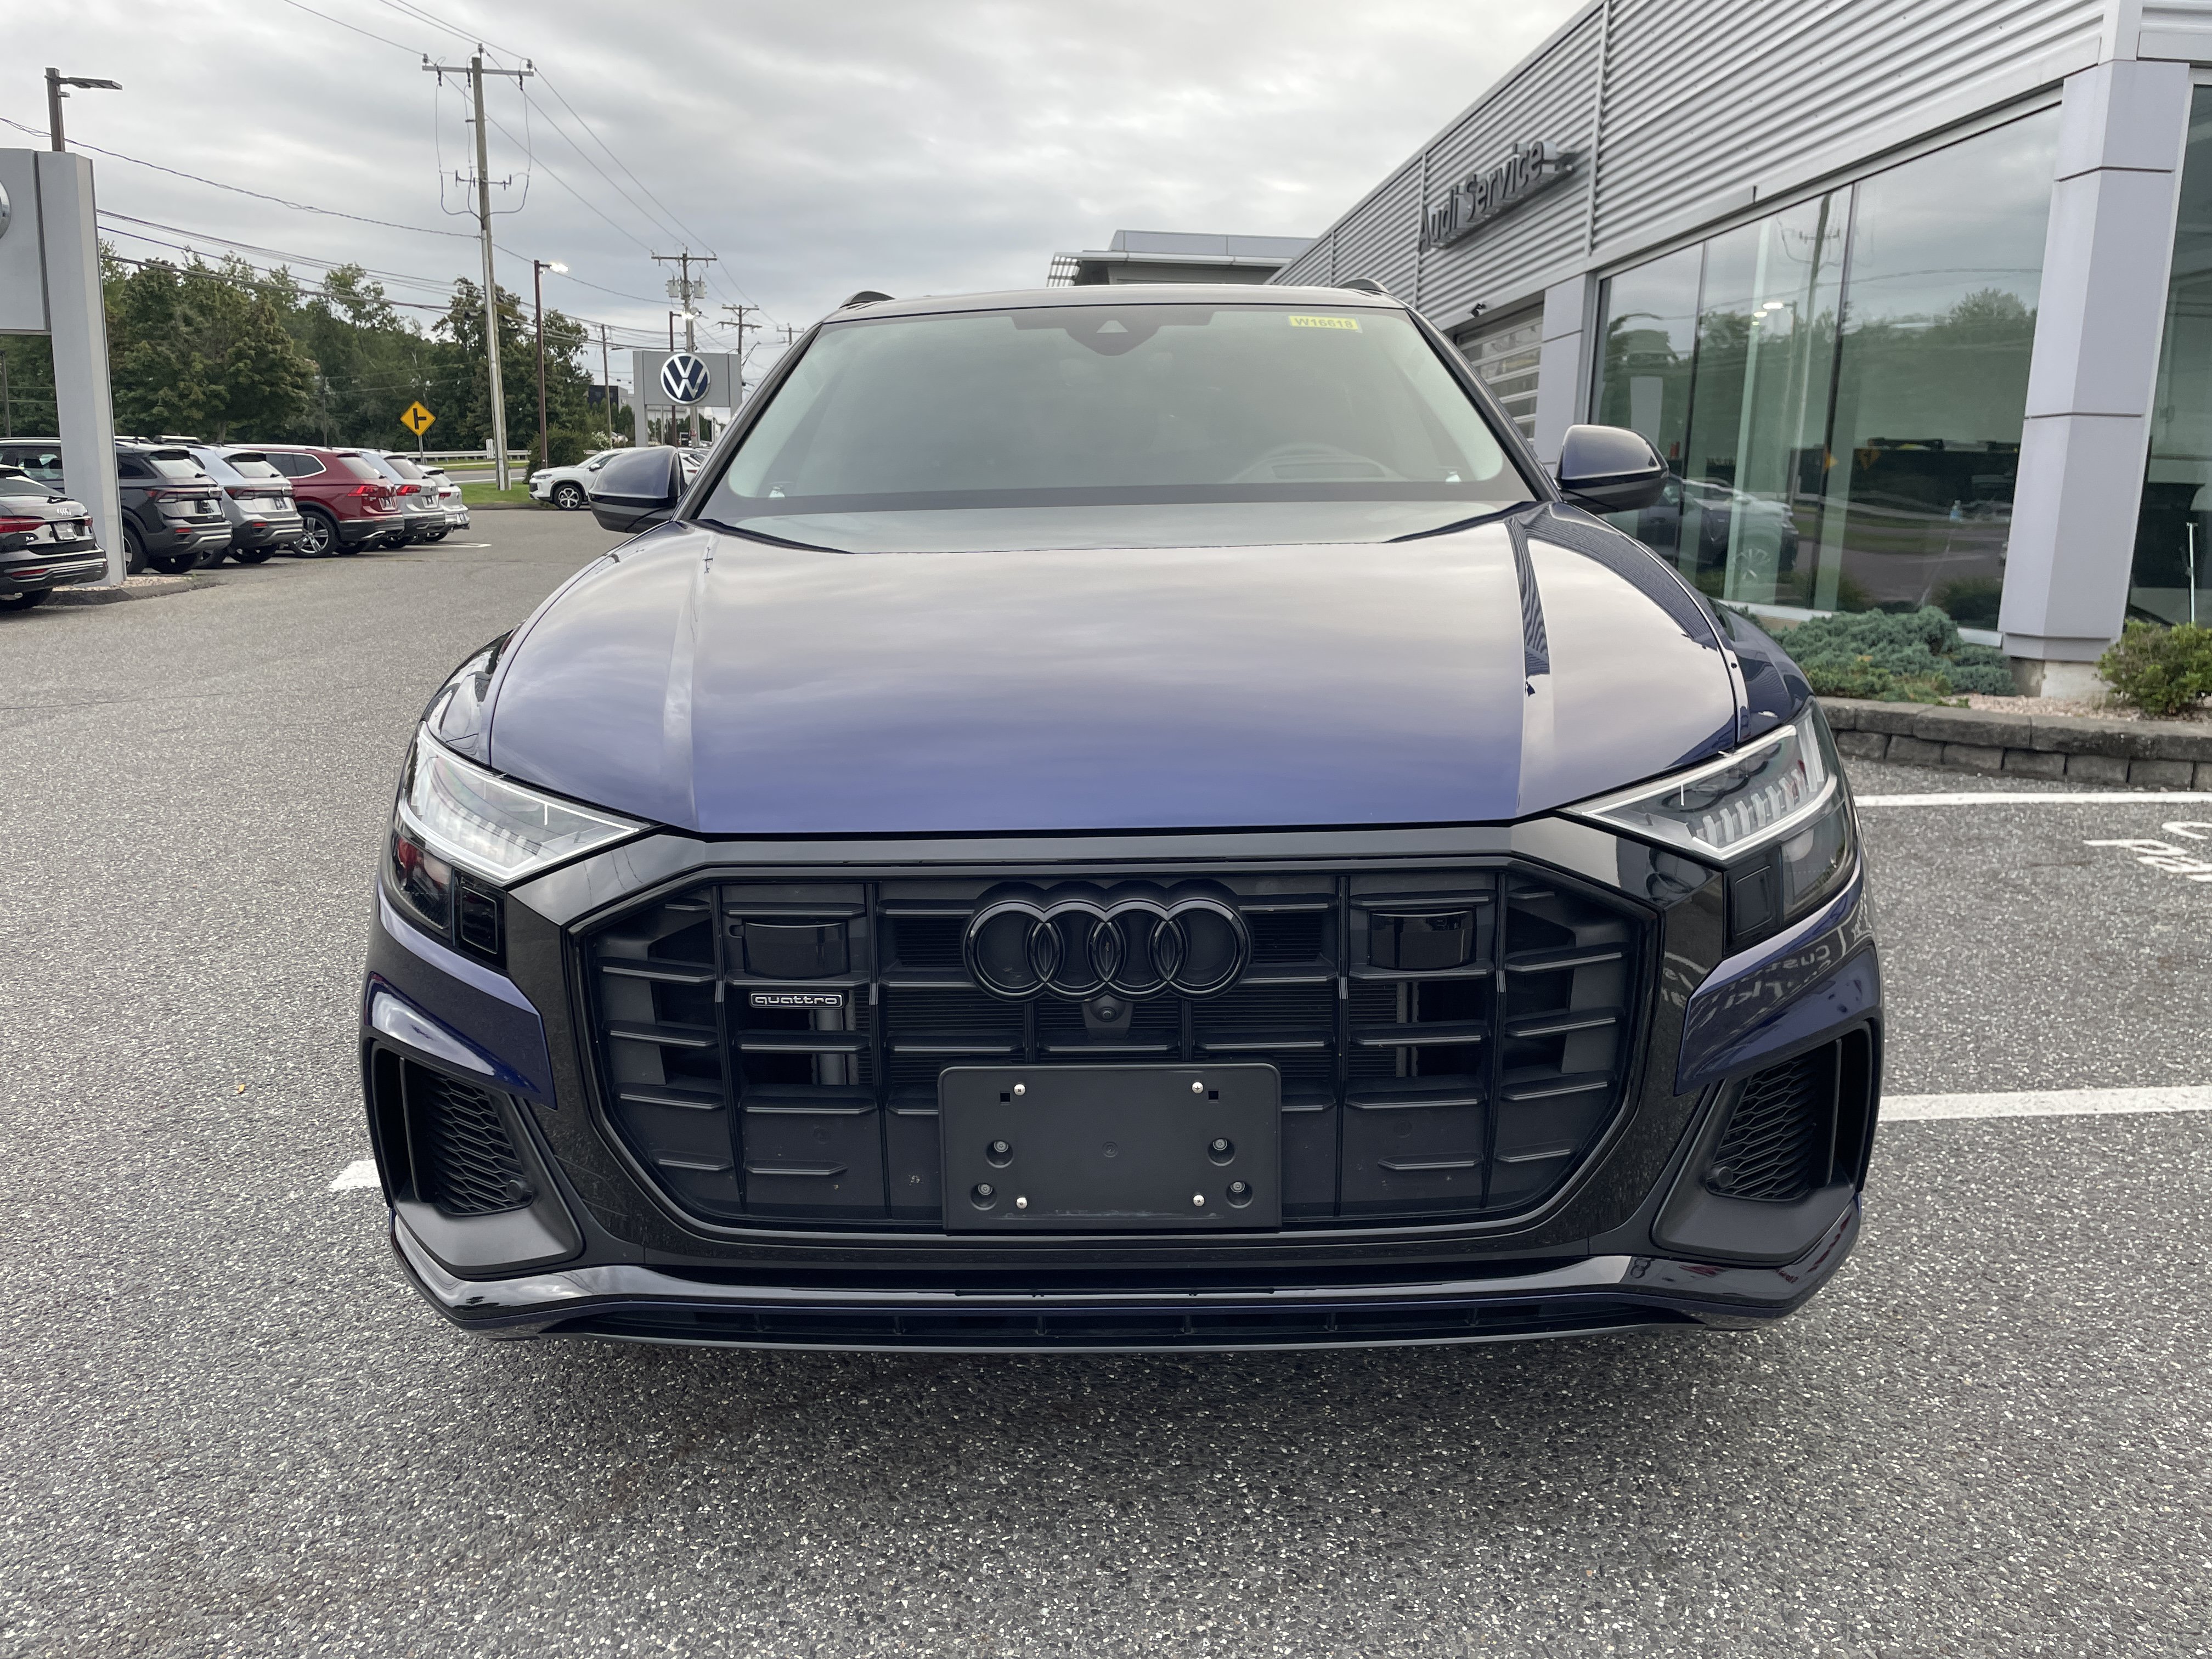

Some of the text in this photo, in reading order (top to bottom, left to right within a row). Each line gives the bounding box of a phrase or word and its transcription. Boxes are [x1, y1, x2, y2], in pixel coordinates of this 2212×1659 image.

[1419, 141, 1544, 252] Audi Service
[1295, 318, 1353, 328] W16618
[754, 996, 838, 1006] quattro
